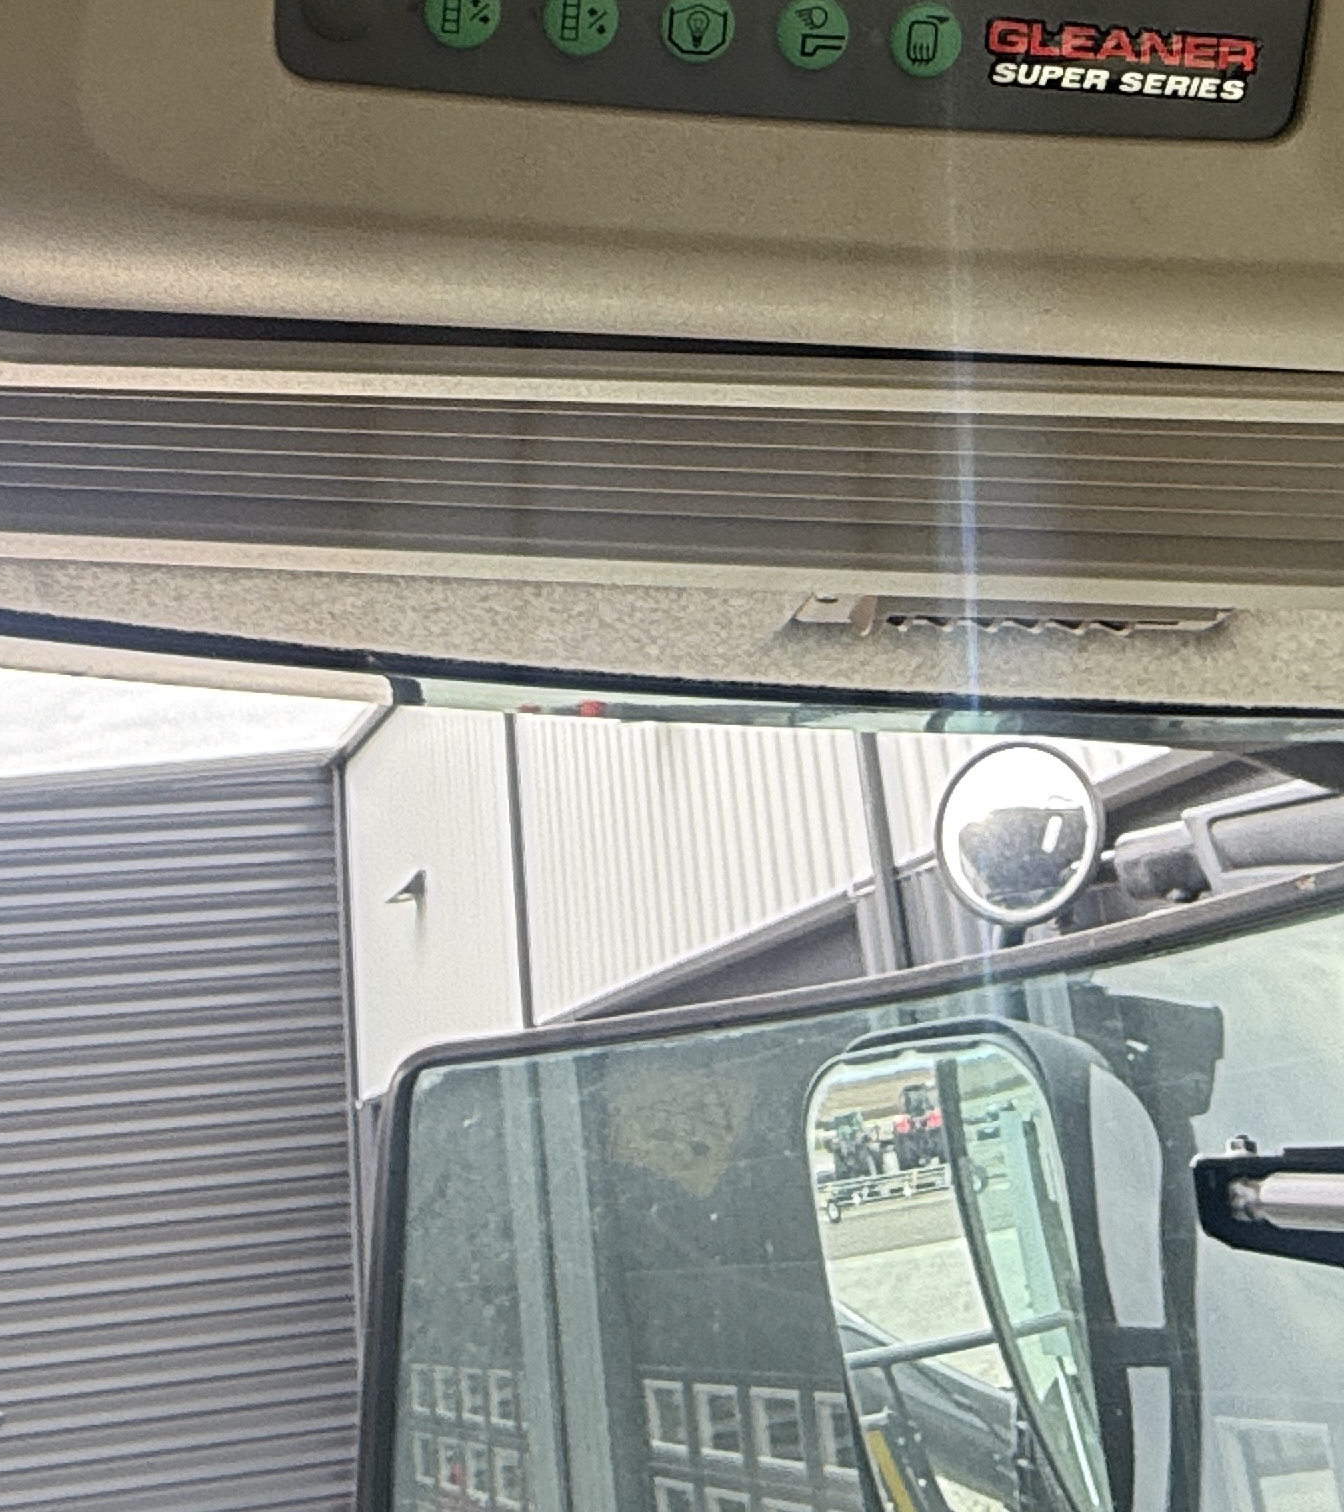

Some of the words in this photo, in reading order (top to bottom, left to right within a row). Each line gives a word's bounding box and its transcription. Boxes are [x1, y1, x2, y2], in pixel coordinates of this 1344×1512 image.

[988, 19, 1256, 72] GLEANER
[992, 62, 1111, 91] SUPER
[1118, 71, 1246, 101] SERIES
